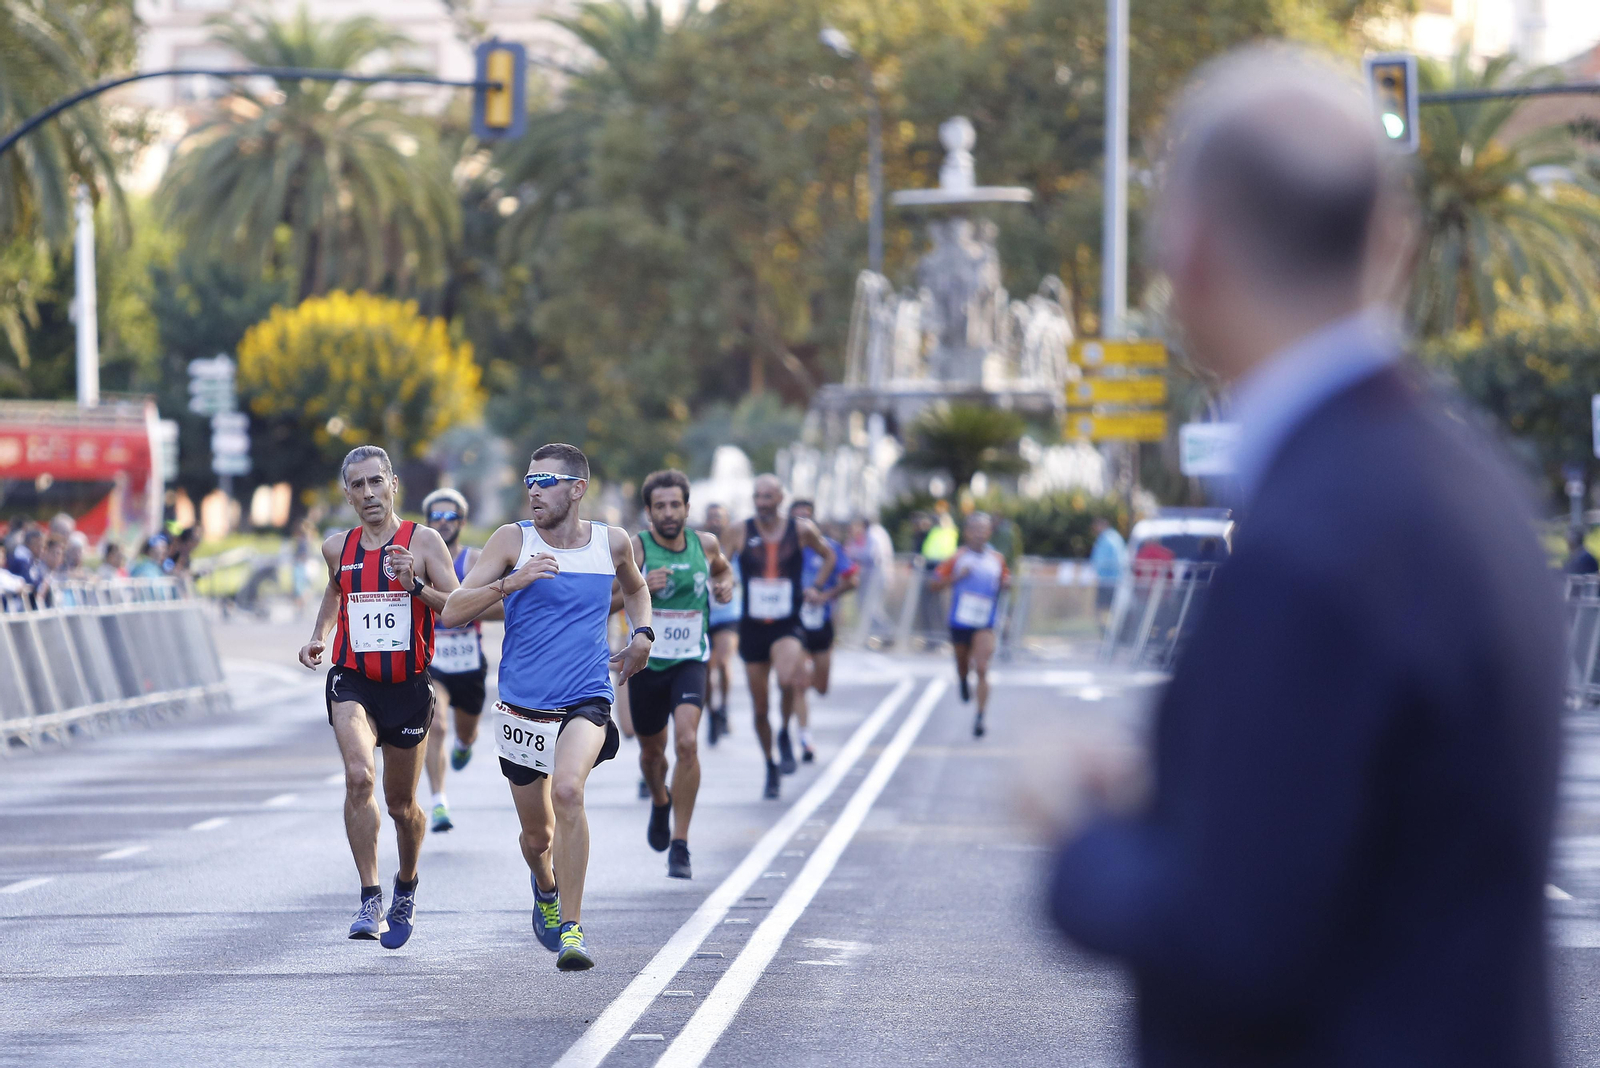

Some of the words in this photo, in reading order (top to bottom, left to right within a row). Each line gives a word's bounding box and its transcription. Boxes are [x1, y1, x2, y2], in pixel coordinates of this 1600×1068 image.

[362, 613, 396, 629] 116
[664, 627, 690, 640] 500
[503, 724, 545, 752] 9078
